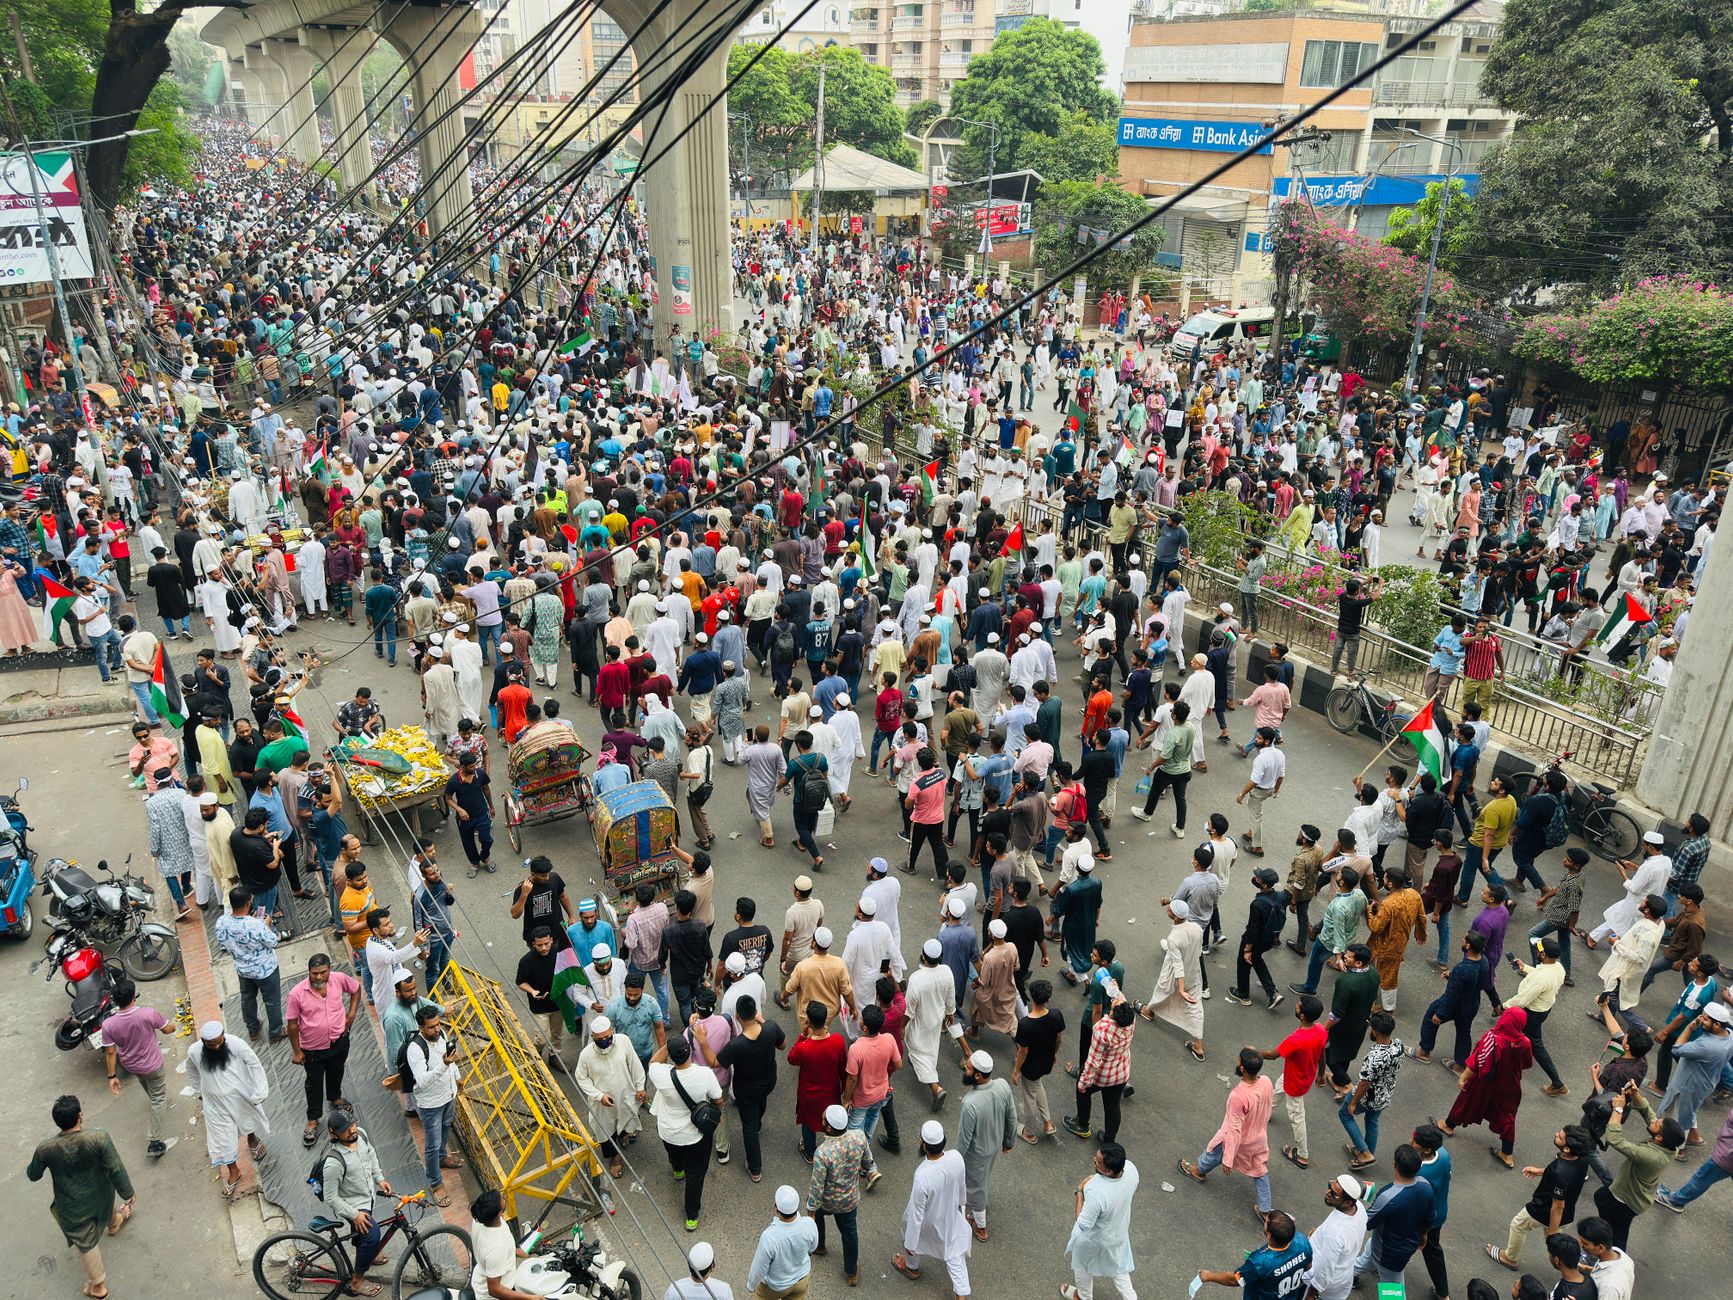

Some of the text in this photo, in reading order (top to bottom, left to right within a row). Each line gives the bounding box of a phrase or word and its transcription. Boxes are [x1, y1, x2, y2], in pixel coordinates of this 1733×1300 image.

[1136, 125, 1182, 142] ব্যাংক এশিয়া
[1207, 127, 1235, 145] Bank
[815, 625, 830, 633] AMIN
[815, 633, 829, 648] 87
[738, 934, 768, 951] SHERIFF
[1273, 1252, 1307, 1277] SHOHEL
[1277, 1268, 1305, 1299] 90
